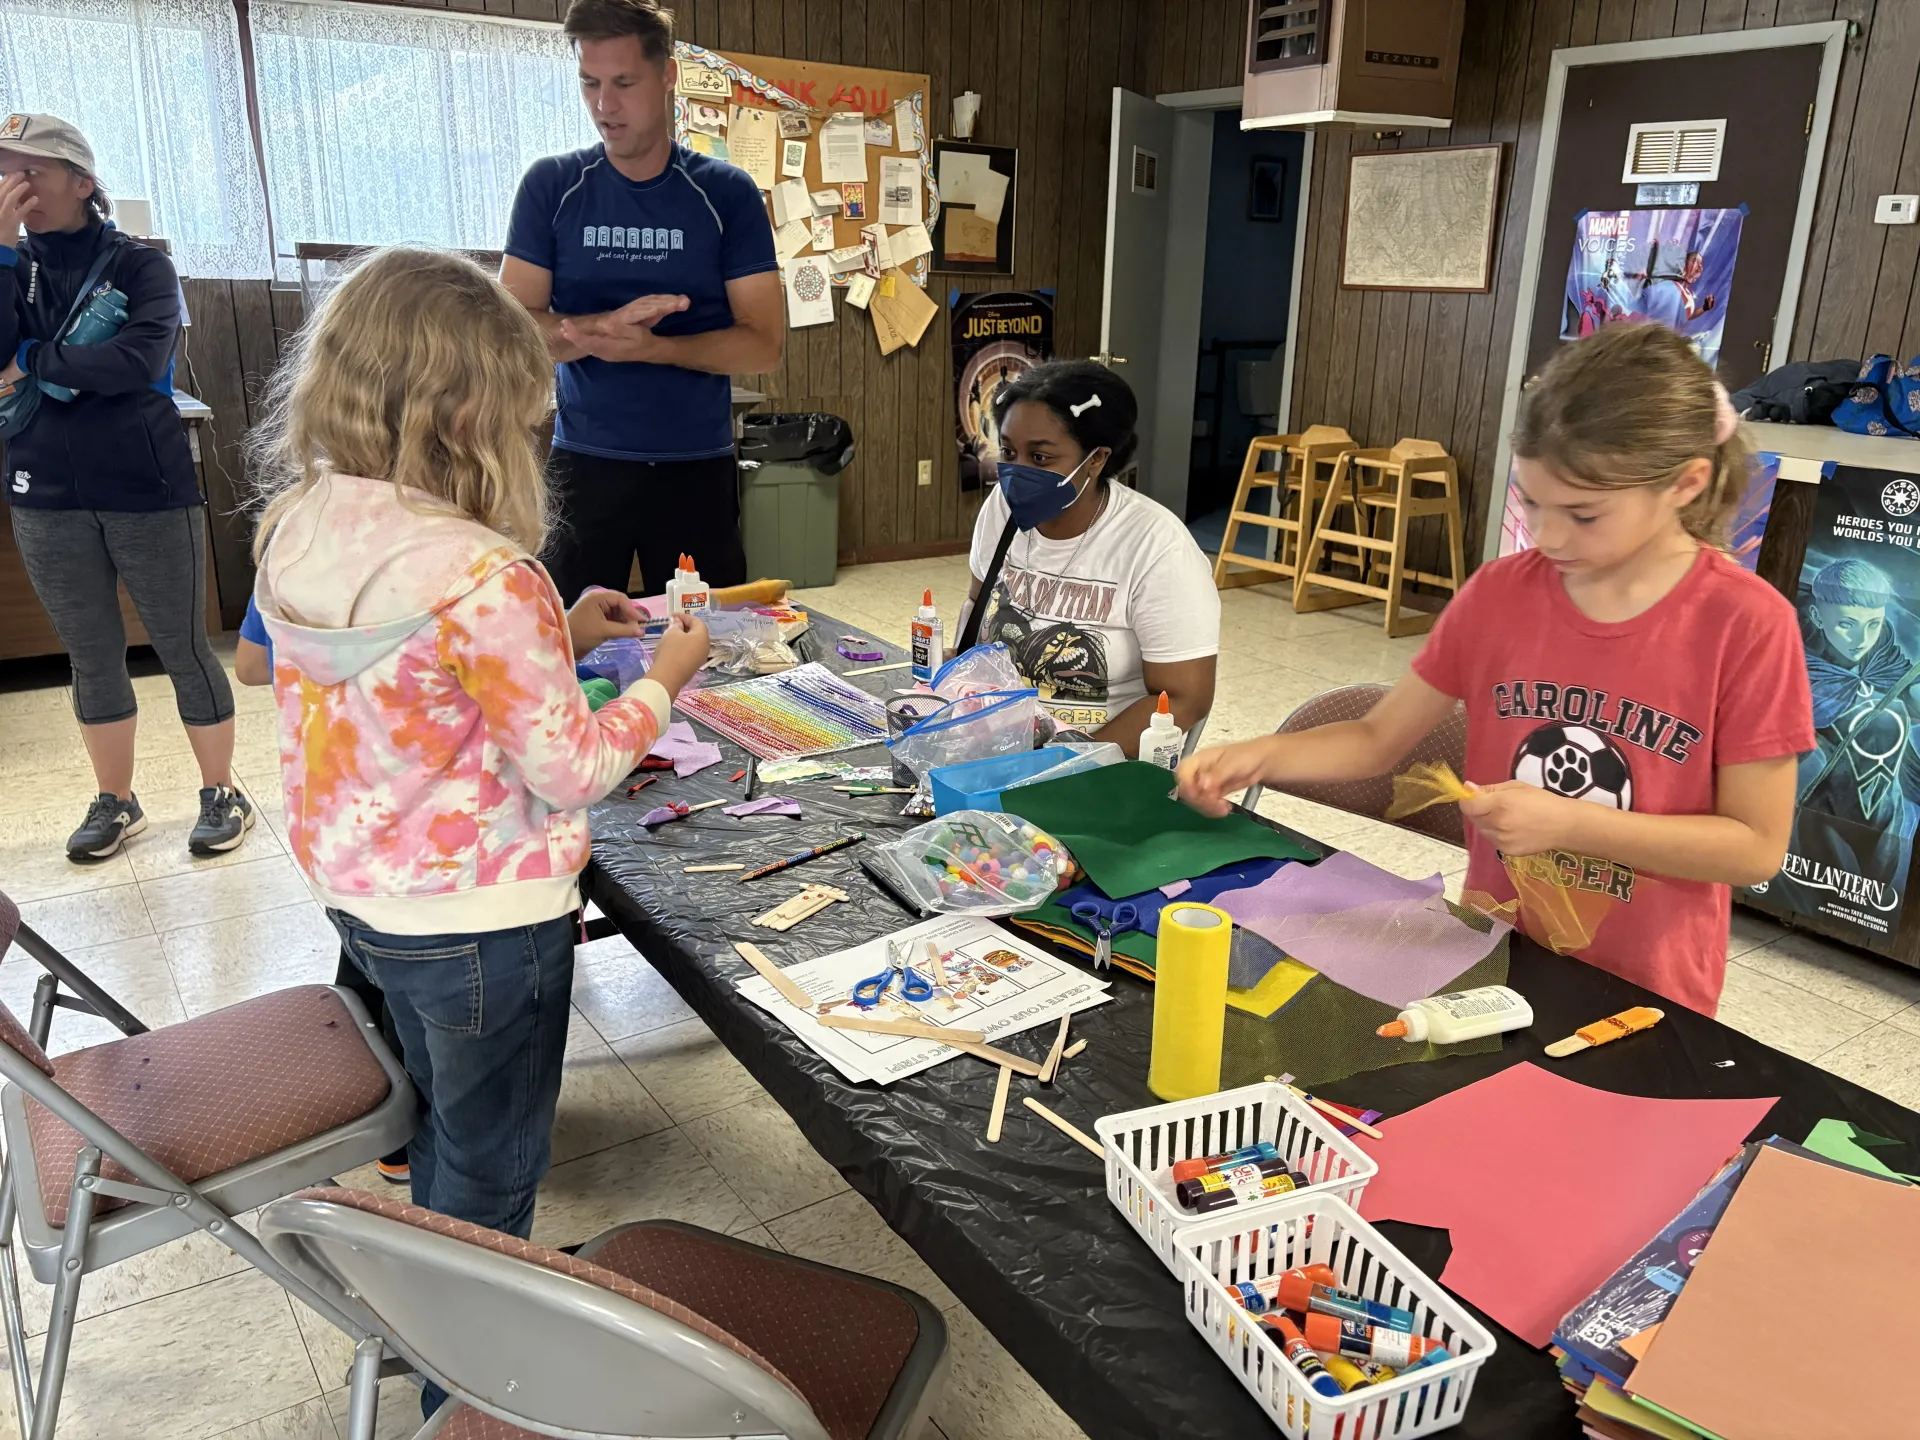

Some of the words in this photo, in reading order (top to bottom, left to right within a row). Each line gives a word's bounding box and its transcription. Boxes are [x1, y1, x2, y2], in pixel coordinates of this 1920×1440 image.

[1372, 53, 1432, 66] REZNOR
[1588, 217, 1630, 236] MARVEL
[1578, 237, 1636, 252] VOICES
[596, 251, 612, 261] just
[613, 250, 629, 260] can't
[629, 252, 642, 262] get
[643, 251, 668, 263] enough!
[962, 317, 996, 339] JUST
[996, 315, 1043, 335] BEYOND
[1836, 514, 1884, 530] HEROES
[1887, 521, 1912, 535] YOU
[1833, 526, 1884, 543] WORLDS
[1888, 534, 1912, 547] YOU
[1054, 581, 1117, 624] TITAN
[1492, 680, 1705, 765] CAROLINE
[1783, 853, 1811, 877] EEN
[1813, 862, 1885, 905] LANTERN
[1839, 891, 1868, 906] DARK
[1850, 909, 1863, 918] TATE
[1050, 983, 1092, 1006] CREATE
[1013, 1003, 1049, 1023] YOUR
[884, 1052, 930, 1074] STRIP!
